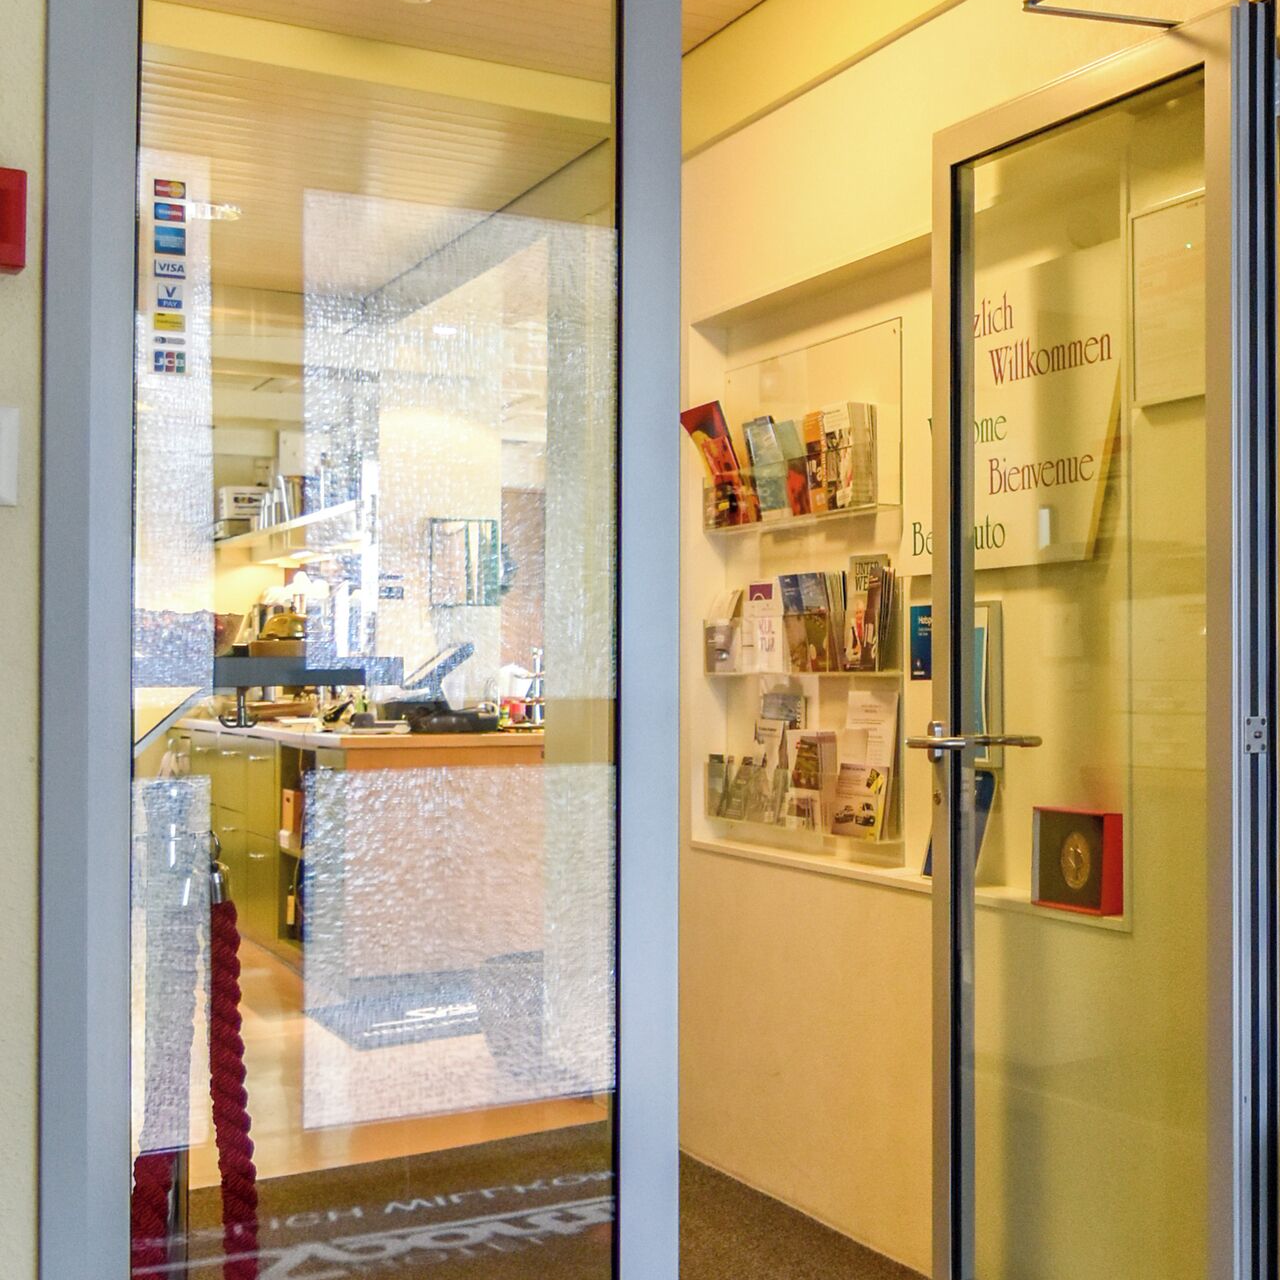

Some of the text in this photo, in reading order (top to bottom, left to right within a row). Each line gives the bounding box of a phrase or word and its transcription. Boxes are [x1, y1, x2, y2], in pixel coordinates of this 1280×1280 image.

[158, 263, 185, 273] VISA
[163, 300, 178, 308] PAY
[165, 286, 177, 298] V
[974, 291, 1014, 339] zlich
[988, 333, 1112, 386] Willkommen
[988, 454, 1094, 495] Bienvenue
